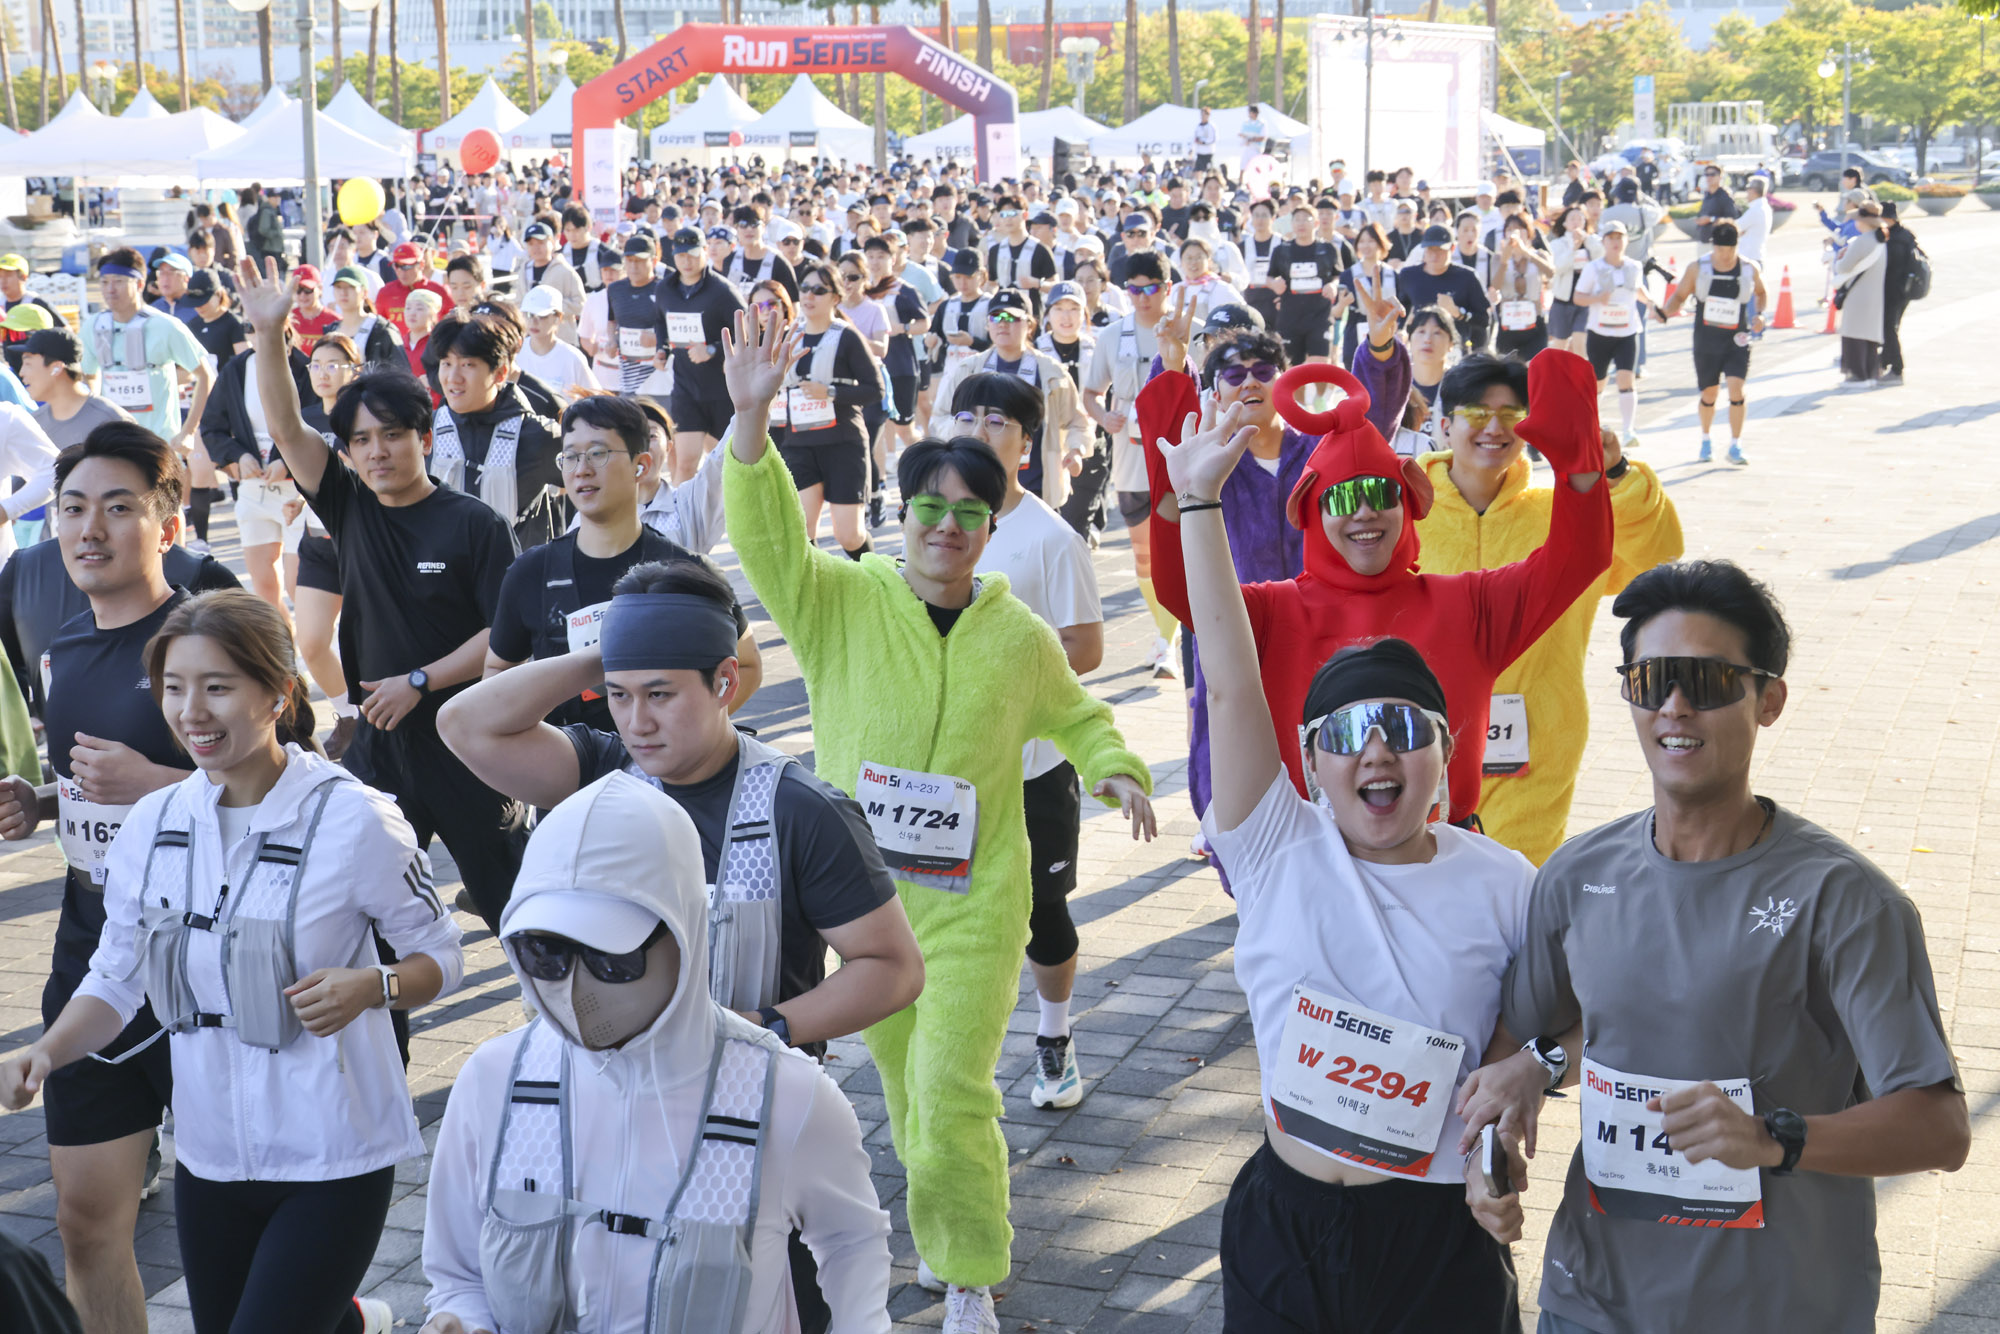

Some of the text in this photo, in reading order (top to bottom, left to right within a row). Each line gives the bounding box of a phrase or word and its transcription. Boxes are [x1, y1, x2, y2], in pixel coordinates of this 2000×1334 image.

[616, 46, 690, 104] START
[914, 44, 992, 102] FINISH
[935, 145, 973, 158] PRES
[905, 781, 940, 795] A-237
[867, 800, 960, 830] M 1724
[66, 818, 122, 844] M 163
[1425, 1035, 1459, 1052] 10km
[1298, 1043, 1432, 1108] W 2294
[1289, 1090, 1314, 1106] Bag Drop
[1386, 1125, 1415, 1138] Race Pack
[1597, 1120, 1674, 1156] M 14
[1610, 1171, 1625, 1181] Drop
[1646, 1162, 1681, 1179] 홍세현
[1720, 1184, 1735, 1192] Pack
